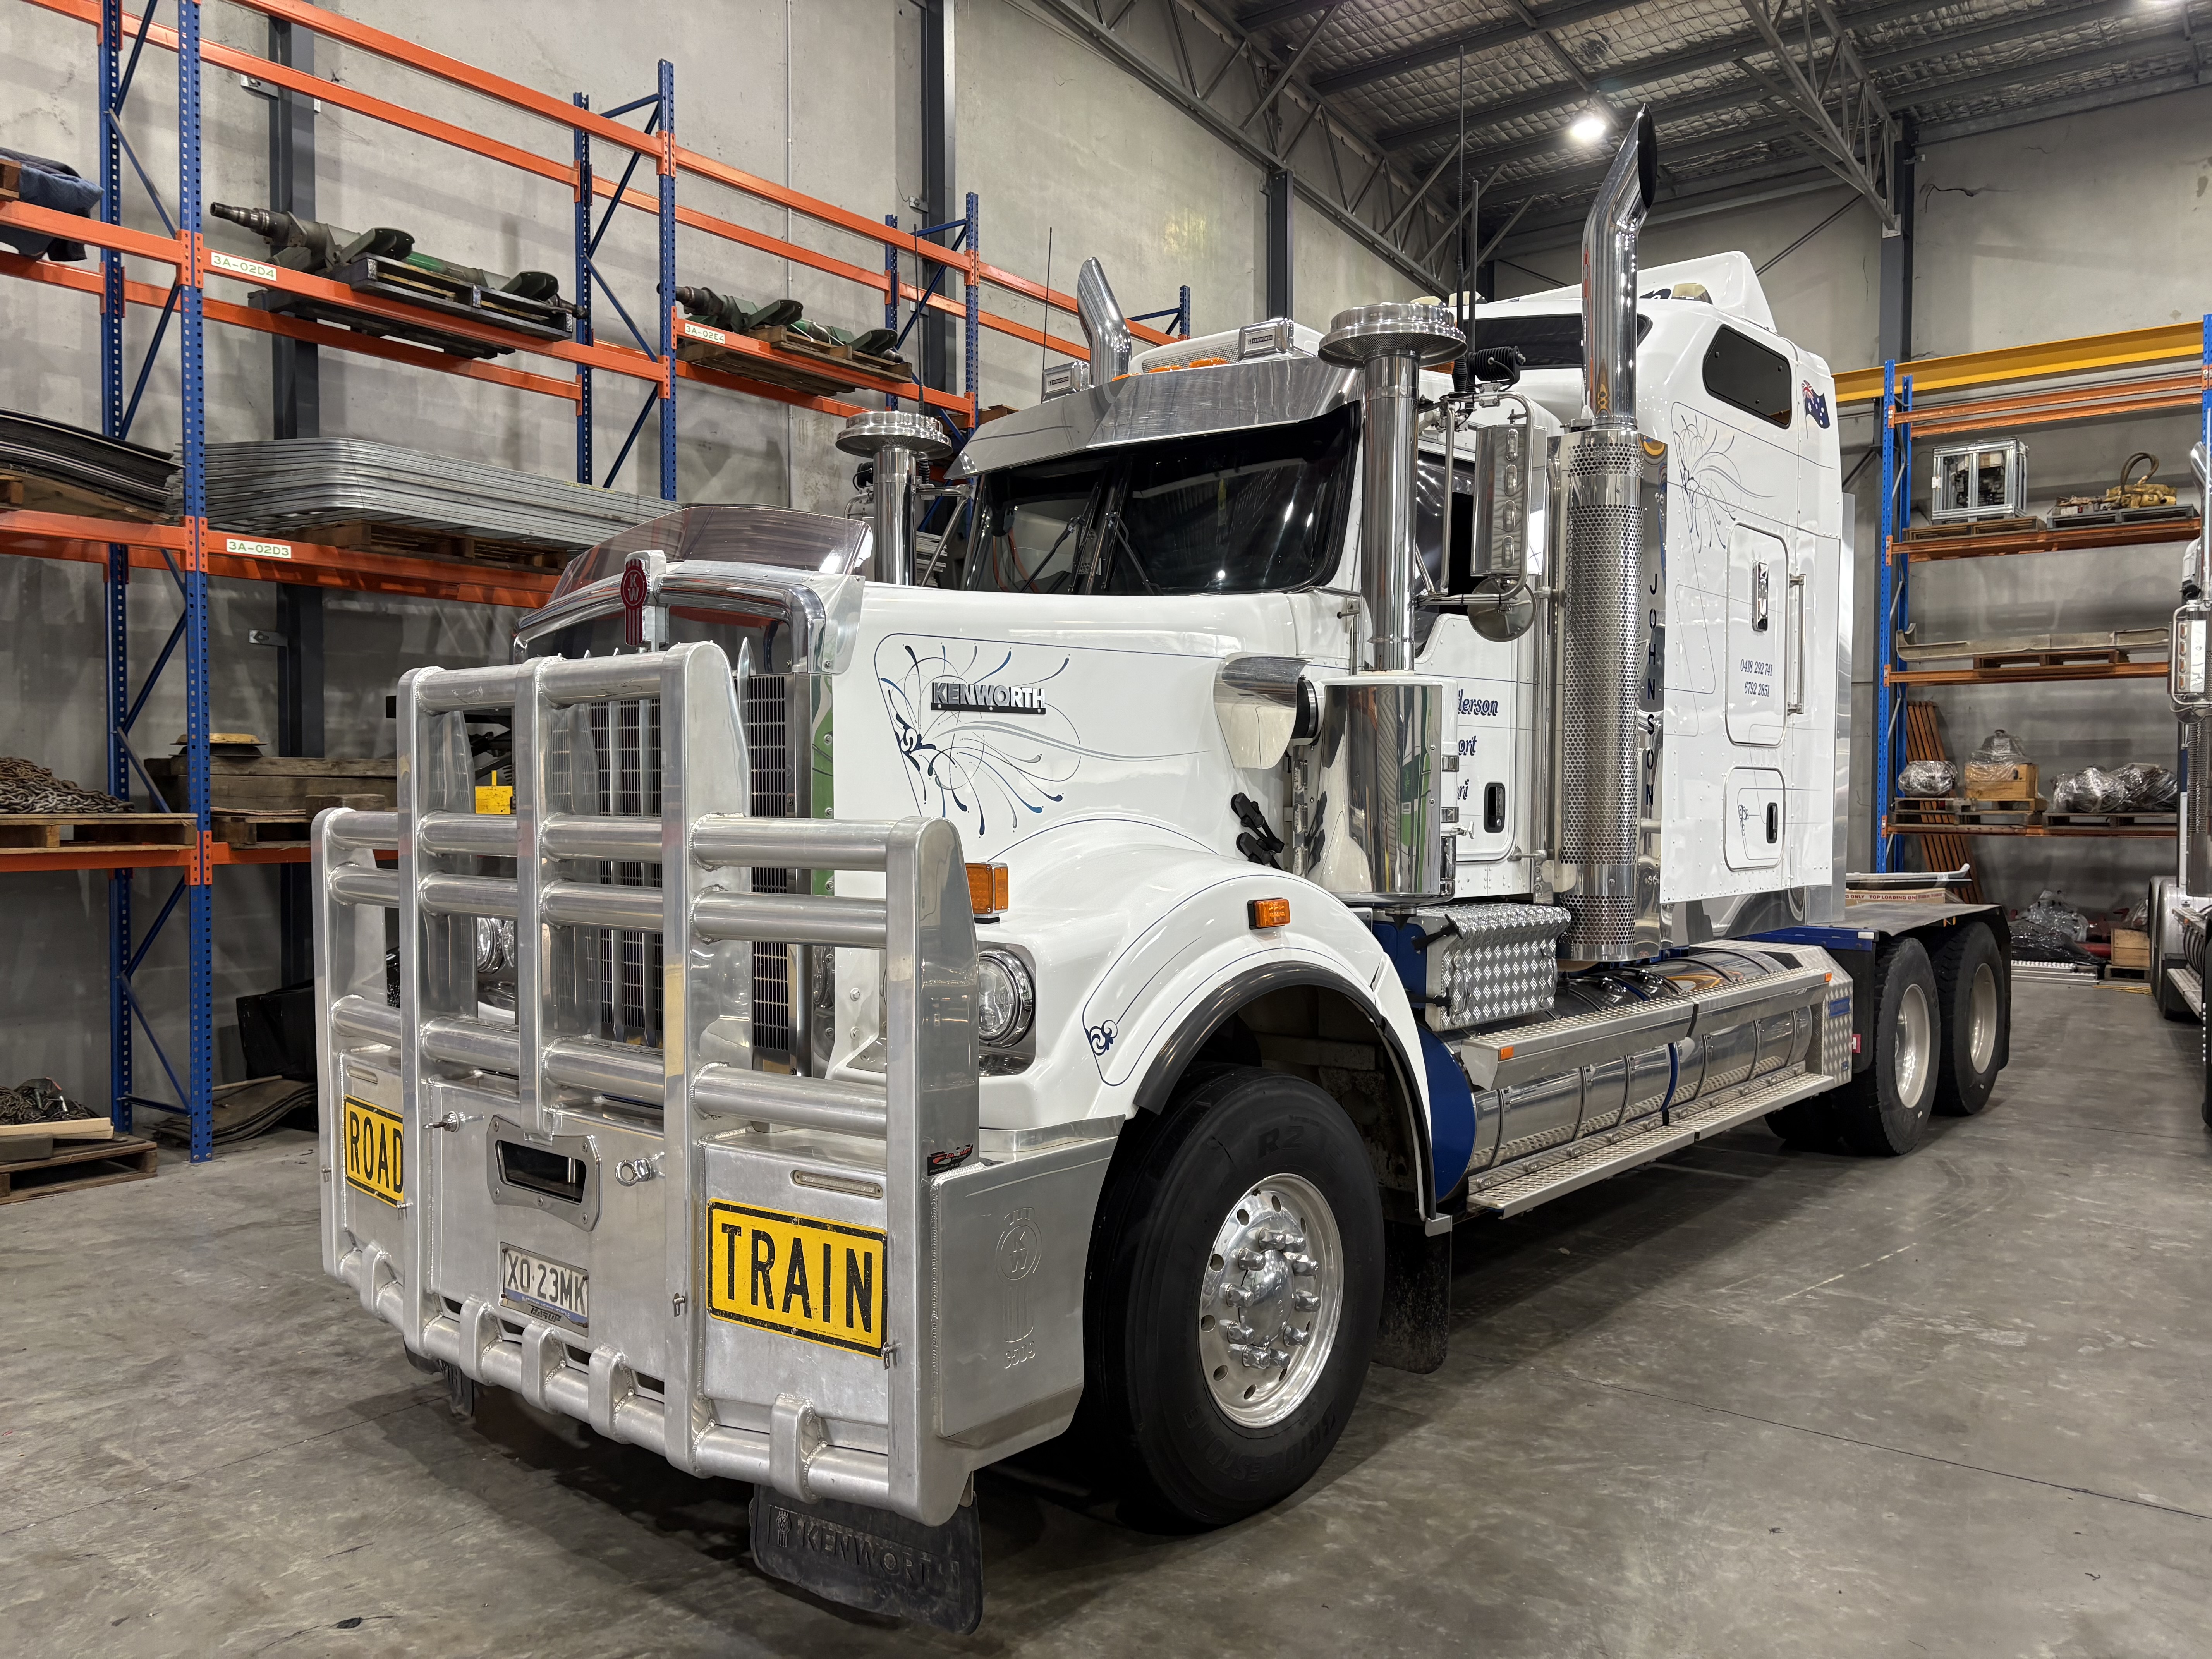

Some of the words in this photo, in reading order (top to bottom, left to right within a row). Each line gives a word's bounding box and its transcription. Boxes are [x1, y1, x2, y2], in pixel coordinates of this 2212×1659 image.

[214, 256, 274, 278] 3A-02D4
[686, 325, 724, 342] 3A-02E4
[229, 541, 289, 556] 3A-02D3
[1740, 659, 1753, 673] 0418
[1754, 661, 1764, 675] 292
[1765, 663, 1773, 676] 741
[932, 682, 1045, 708] KENWORTH
[1744, 681, 1757, 695] 6792
[1758, 683, 1770, 697] 2851
[350, 1110, 403, 1194] ROAD
[721, 1223, 872, 1333] TRAIN
